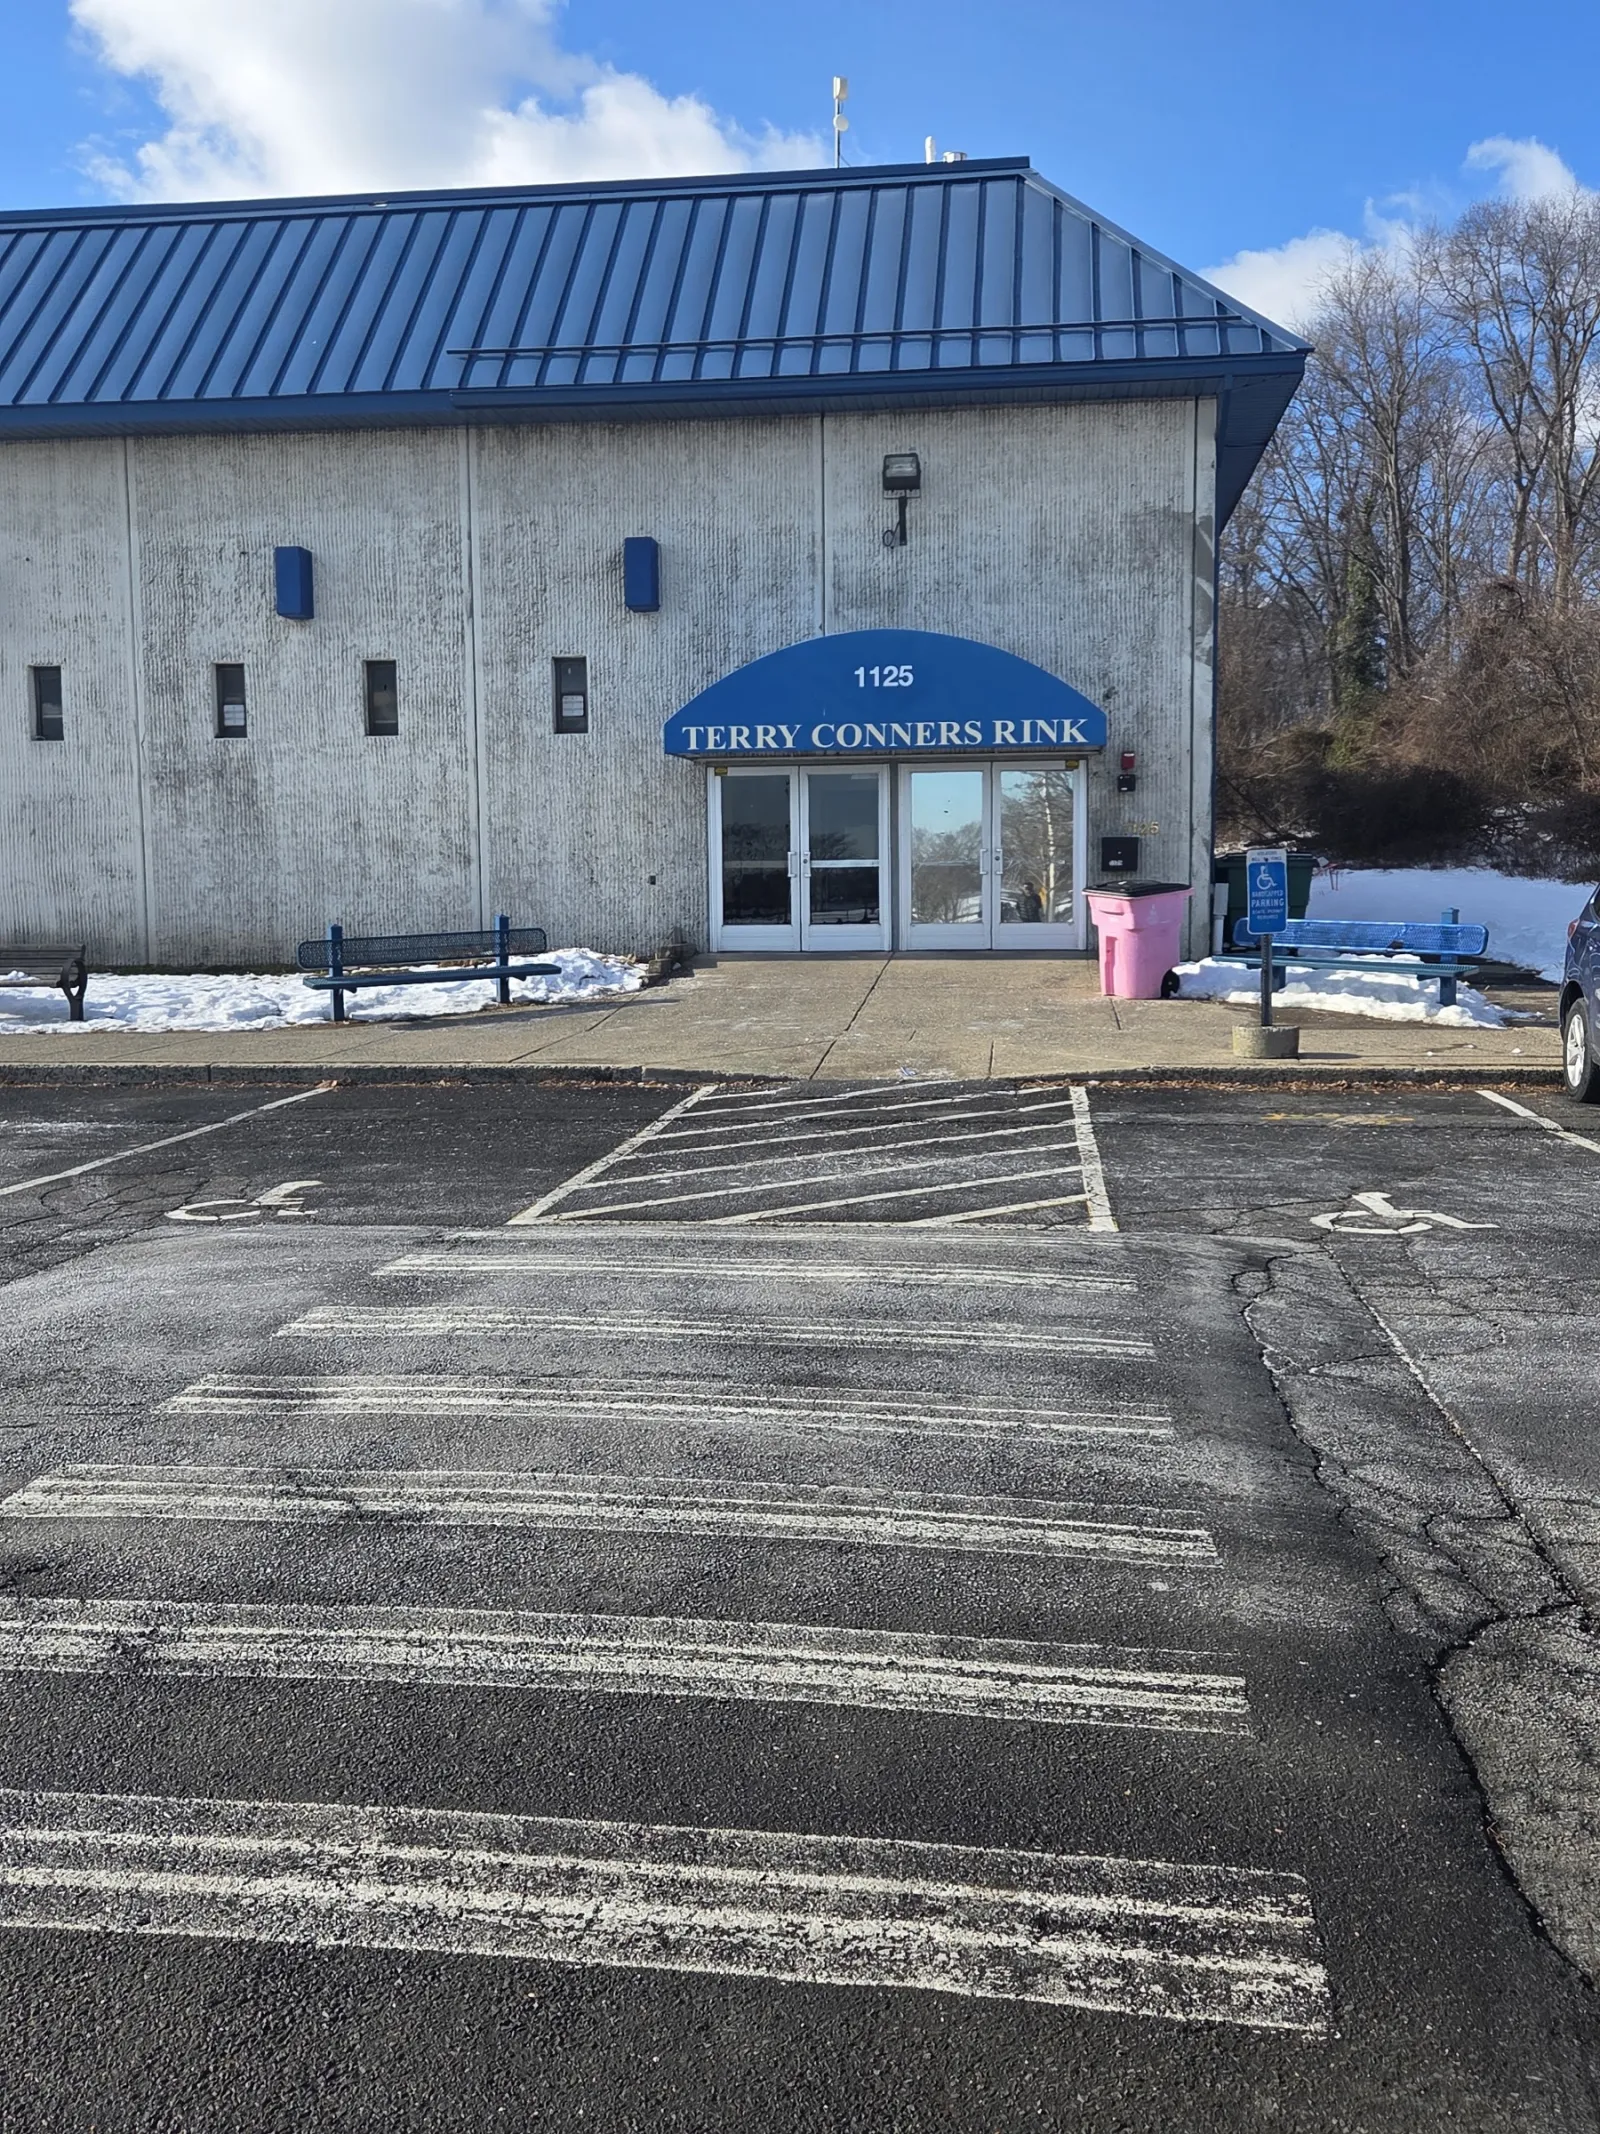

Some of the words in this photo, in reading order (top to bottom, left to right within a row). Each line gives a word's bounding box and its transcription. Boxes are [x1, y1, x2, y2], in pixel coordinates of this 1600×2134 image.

[854, 665, 914, 688] 1125
[682, 724, 802, 750] TERRY
[811, 719, 983, 748] CONNERS
[992, 718, 1089, 744] RINK
[1251, 898, 1284, 908] PARKING
